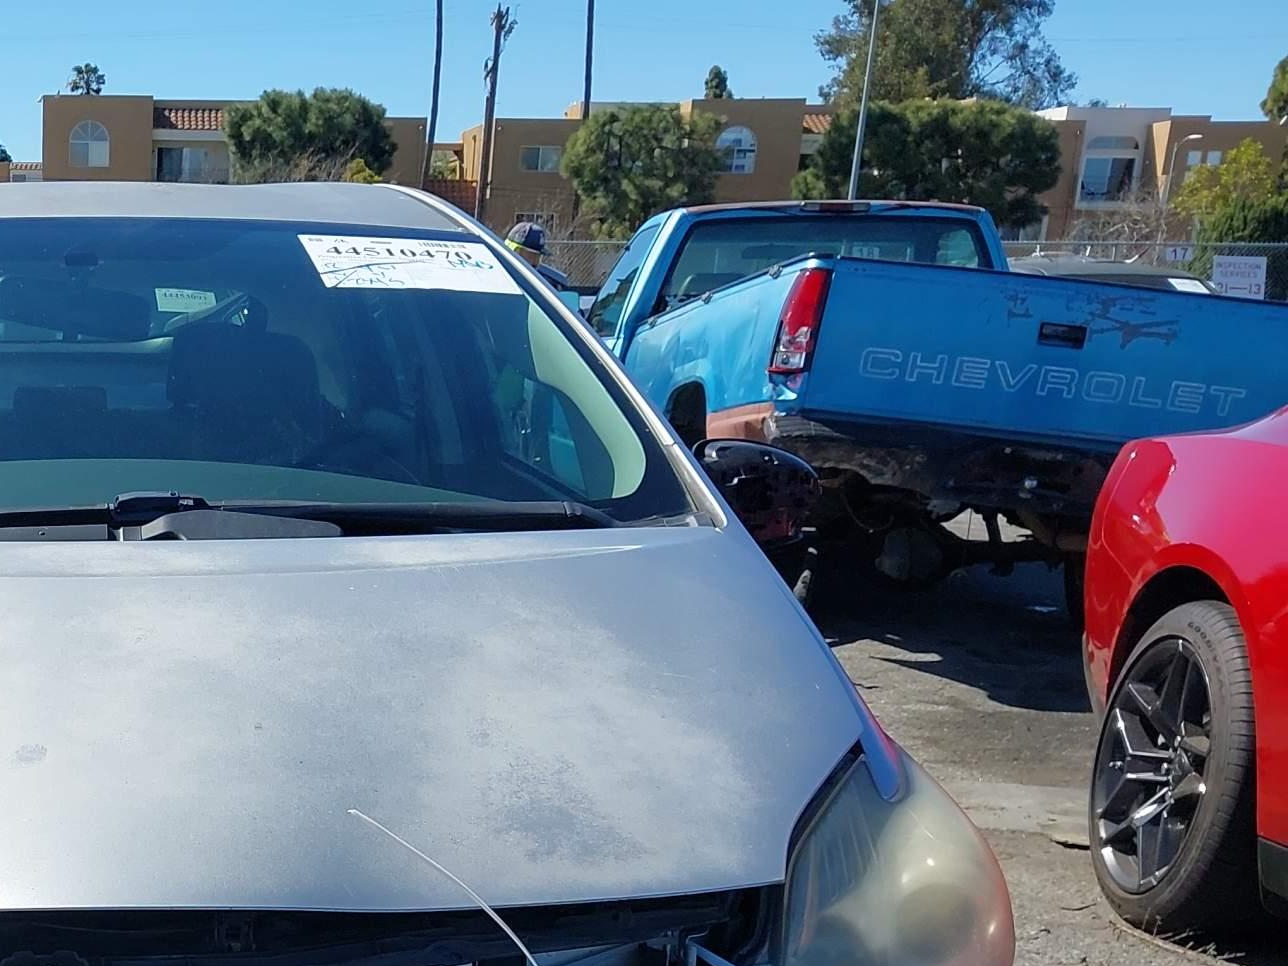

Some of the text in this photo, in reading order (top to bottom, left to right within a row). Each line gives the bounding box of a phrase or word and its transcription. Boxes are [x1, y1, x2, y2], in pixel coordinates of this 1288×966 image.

[326, 246, 472, 260] 44510470
[1170, 247, 1189, 260] 17
[1215, 262, 1262, 270] INSPECTION
[1219, 270, 1258, 279] SERVICES
[859, 347, 1246, 416] CHEVROLET
